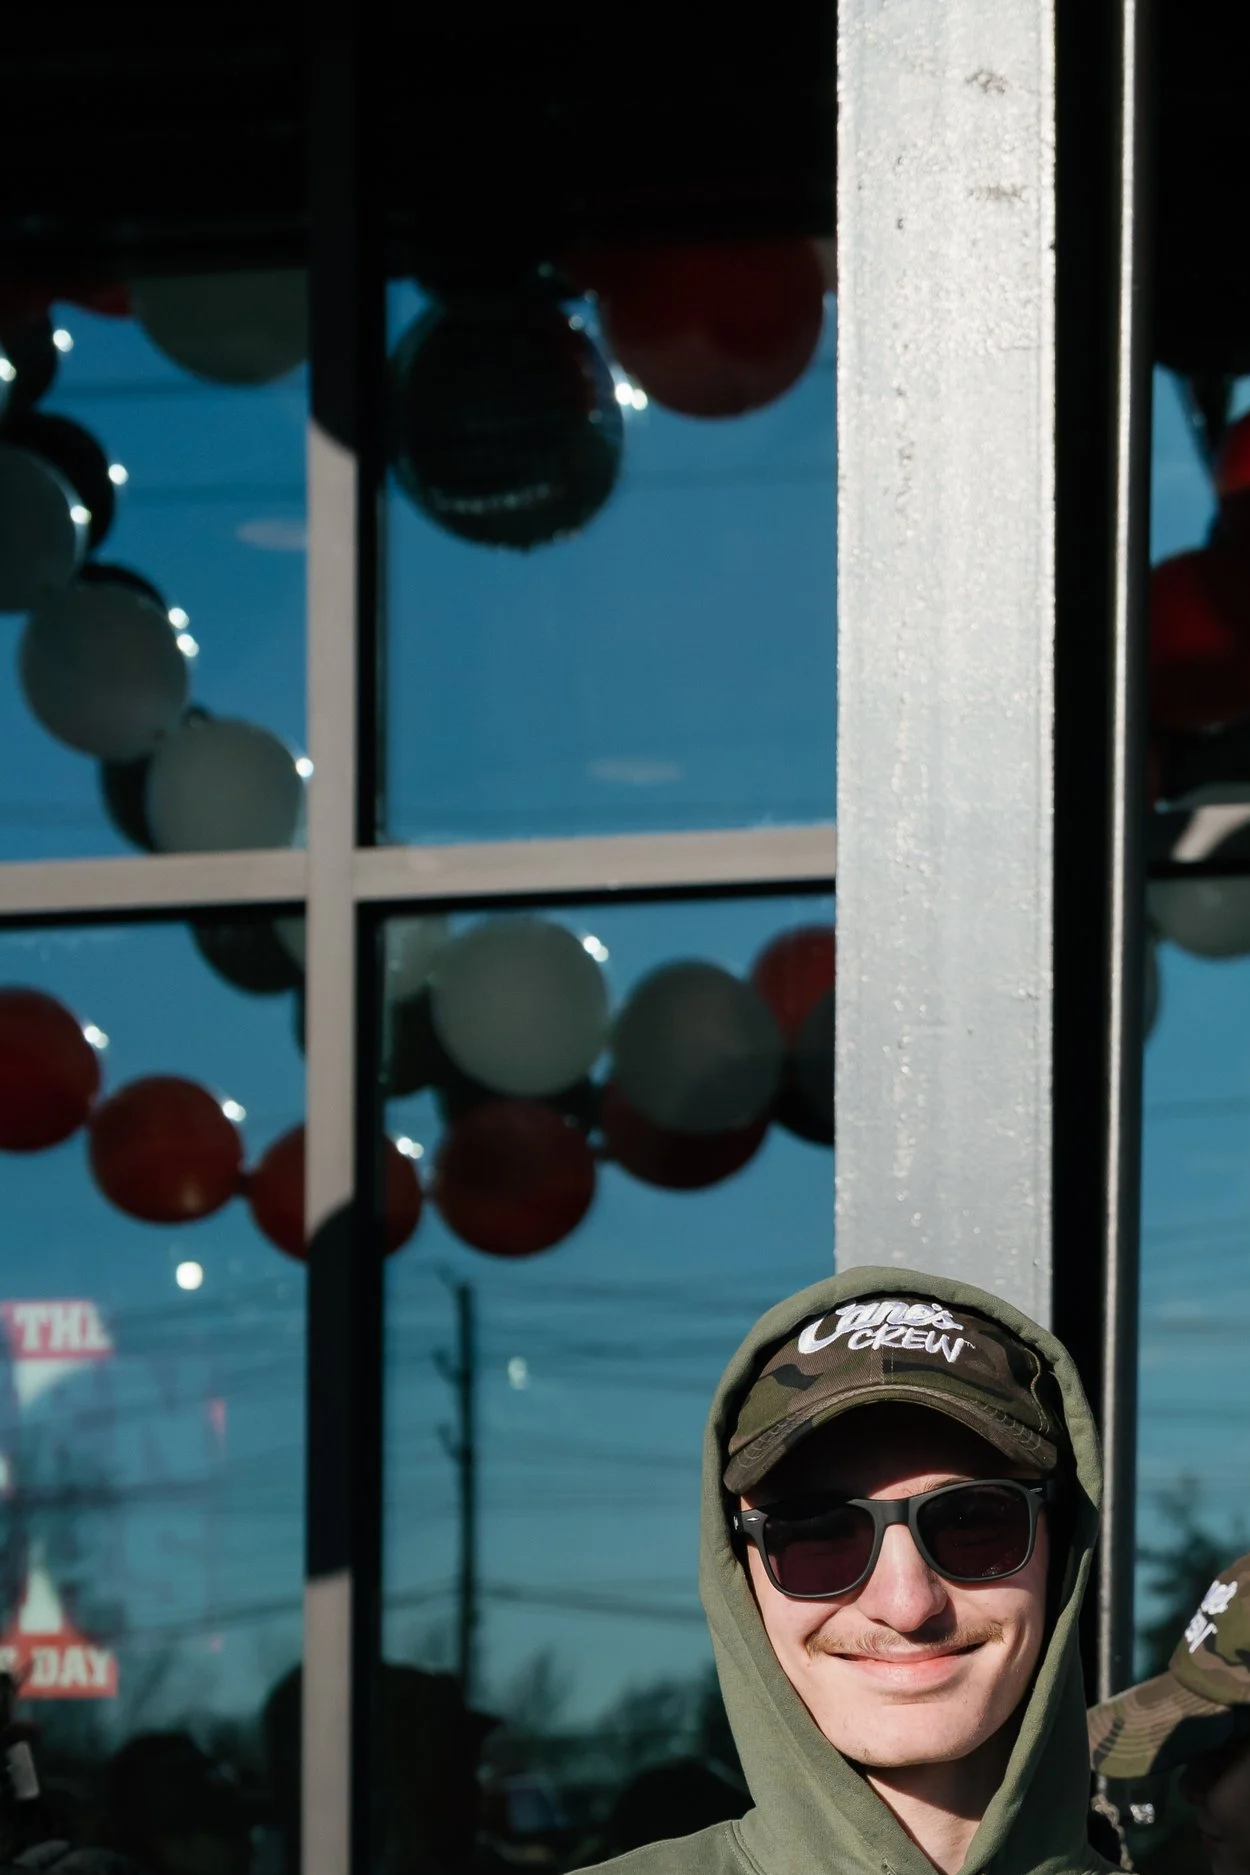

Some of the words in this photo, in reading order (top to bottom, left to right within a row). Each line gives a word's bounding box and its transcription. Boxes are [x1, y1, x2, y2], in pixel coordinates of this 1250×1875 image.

[798, 1301, 963, 1354] Cane's
[848, 1324, 964, 1363] CREW
[31, 1646, 112, 1687] DAY
